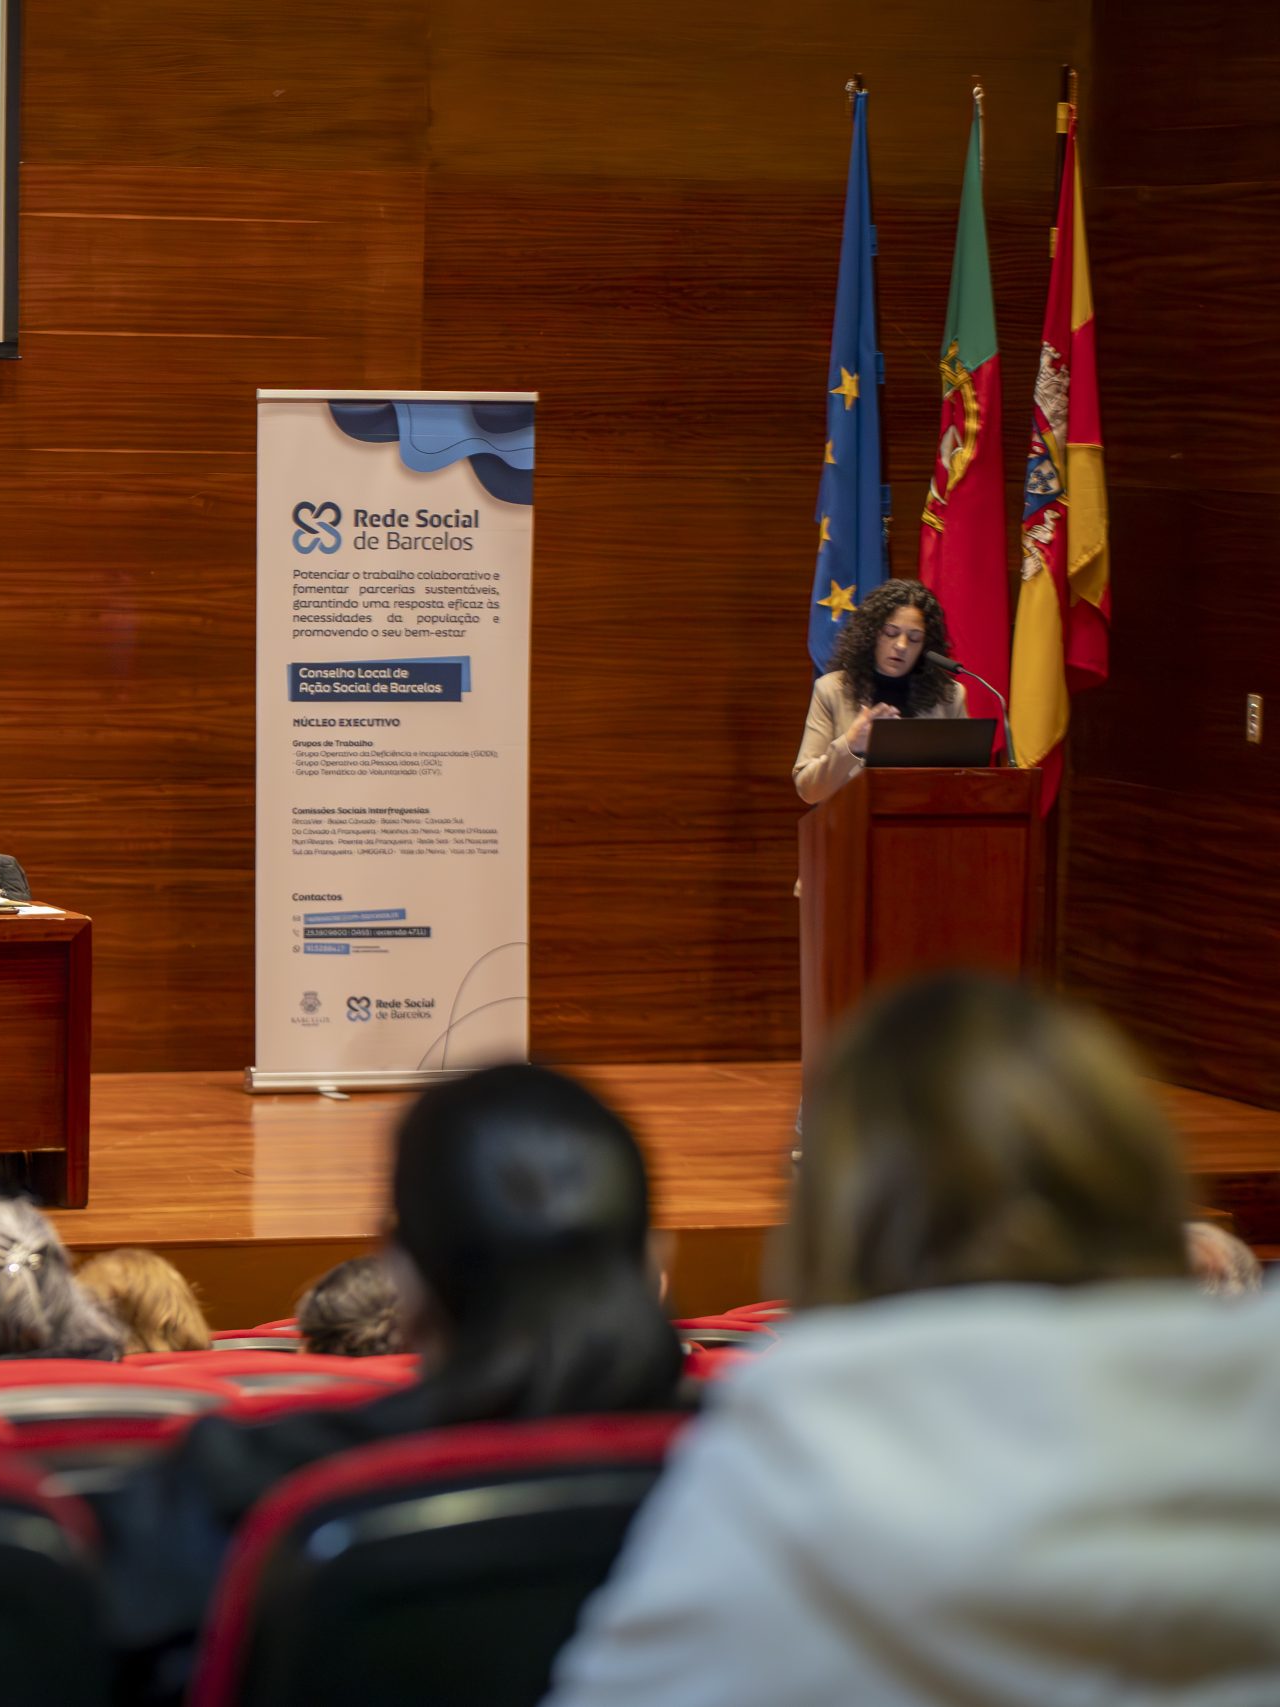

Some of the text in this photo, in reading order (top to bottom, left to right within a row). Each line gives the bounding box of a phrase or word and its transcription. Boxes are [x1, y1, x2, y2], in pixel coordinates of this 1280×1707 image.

[354, 509, 479, 528] Rede Social
[353, 531, 473, 551] de Barcelos
[293, 569, 500, 581] Potenciar o trabalho colaborativo e
[293, 584, 500, 596] fomentar parcerias sustentáveis,
[293, 599, 500, 611] garantindo uma resposta eficaz às
[293, 613, 500, 625] necessidades da população e
[293, 627, 466, 639] promovendo o seu bem-estar
[299, 667, 409, 679] Conselho Local de
[299, 682, 443, 695] Ação Social de Barcelos
[293, 715, 400, 727] NÚCLEO EXECUTIVO
[292, 740, 373, 749] Grupos de Trabalho
[292, 806, 335, 815] Comissões
[337, 807, 367, 815] Sociais
[292, 892, 343, 902] Contactos
[376, 998, 435, 1008] Rede Social
[375, 1009, 431, 1019] de Barcelos
